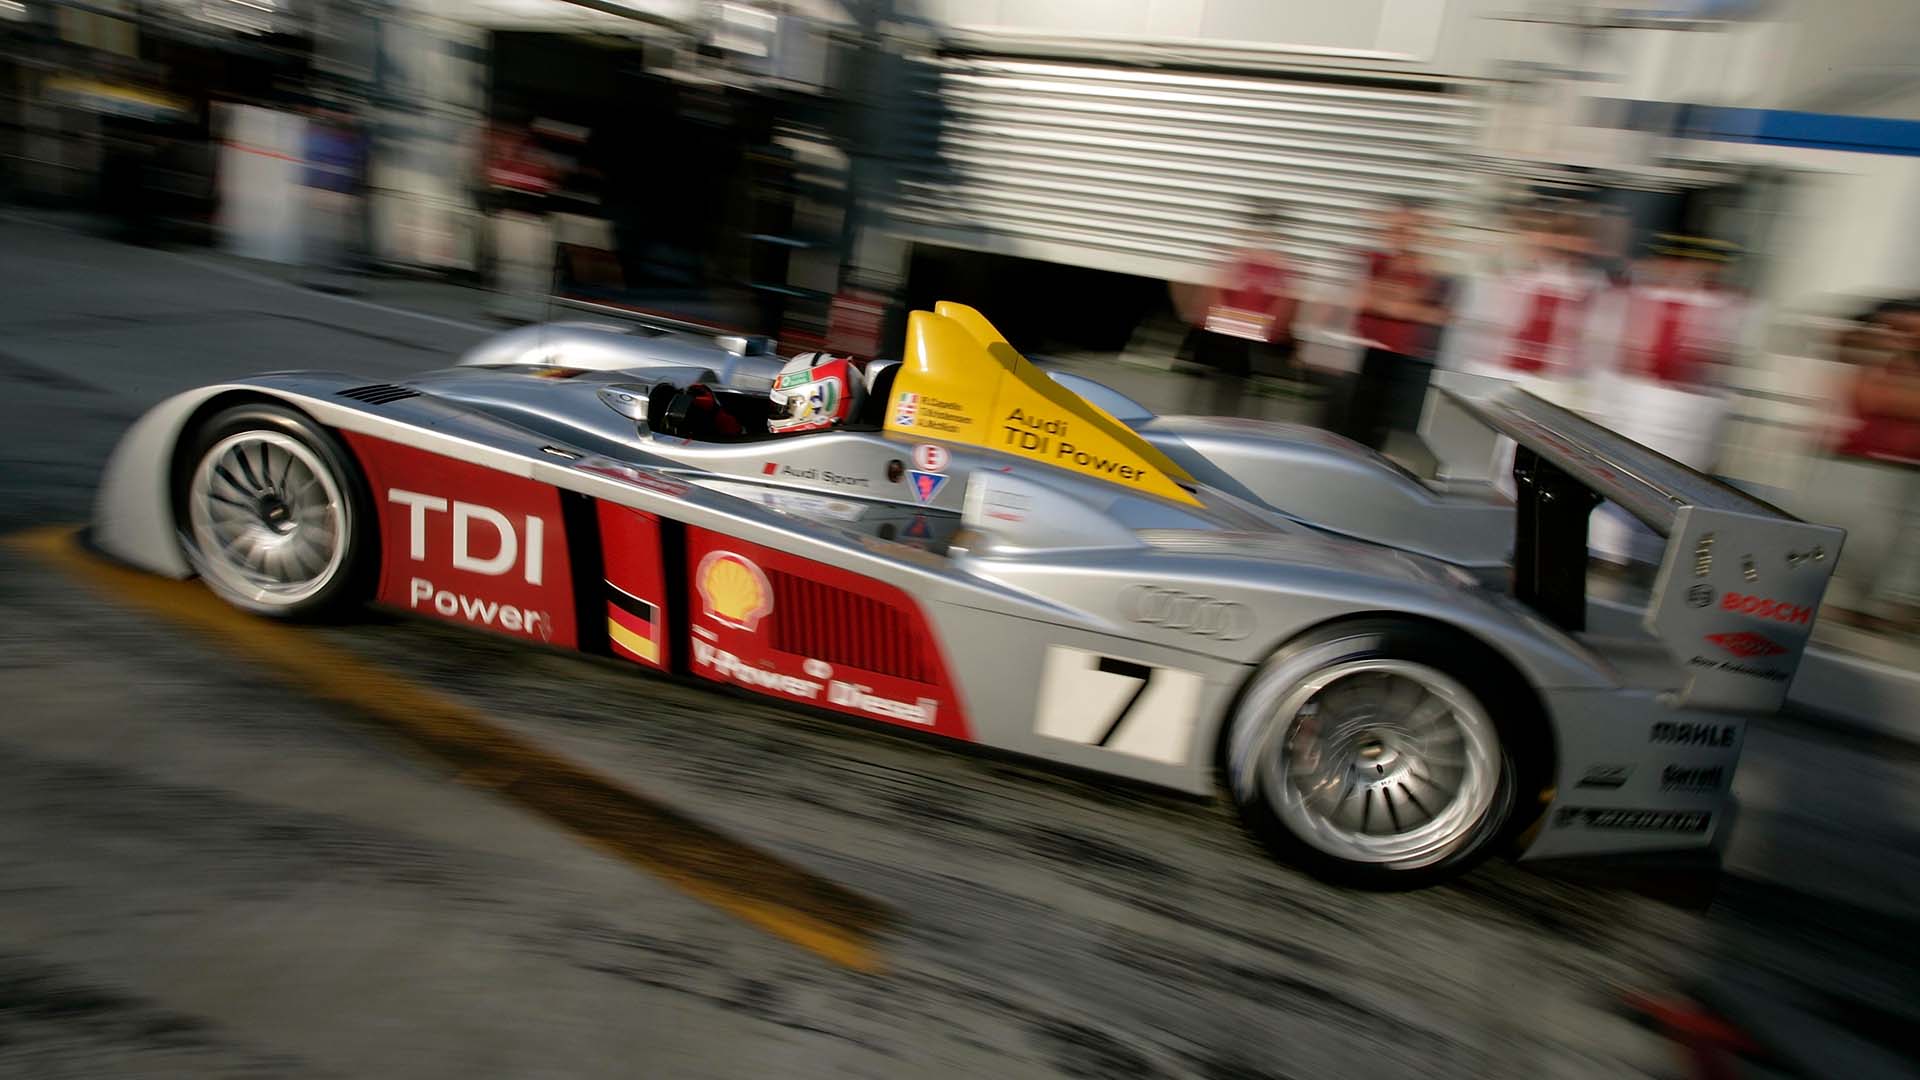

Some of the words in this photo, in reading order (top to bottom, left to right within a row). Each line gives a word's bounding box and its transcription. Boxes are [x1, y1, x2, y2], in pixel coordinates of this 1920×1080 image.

[1006, 408, 1068, 437] Audi
[925, 446, 938, 465] E
[1004, 426, 1049, 454] TDI
[1056, 442, 1146, 482] Power
[782, 465, 816, 481] Audi
[823, 470, 869, 488] Sport
[388, 488, 544, 586] TDI
[411, 576, 545, 634] Power
[1721, 591, 1812, 625] BOSCH
[1090, 655, 1164, 747] 7
[1650, 720, 1736, 748] MAHLE
